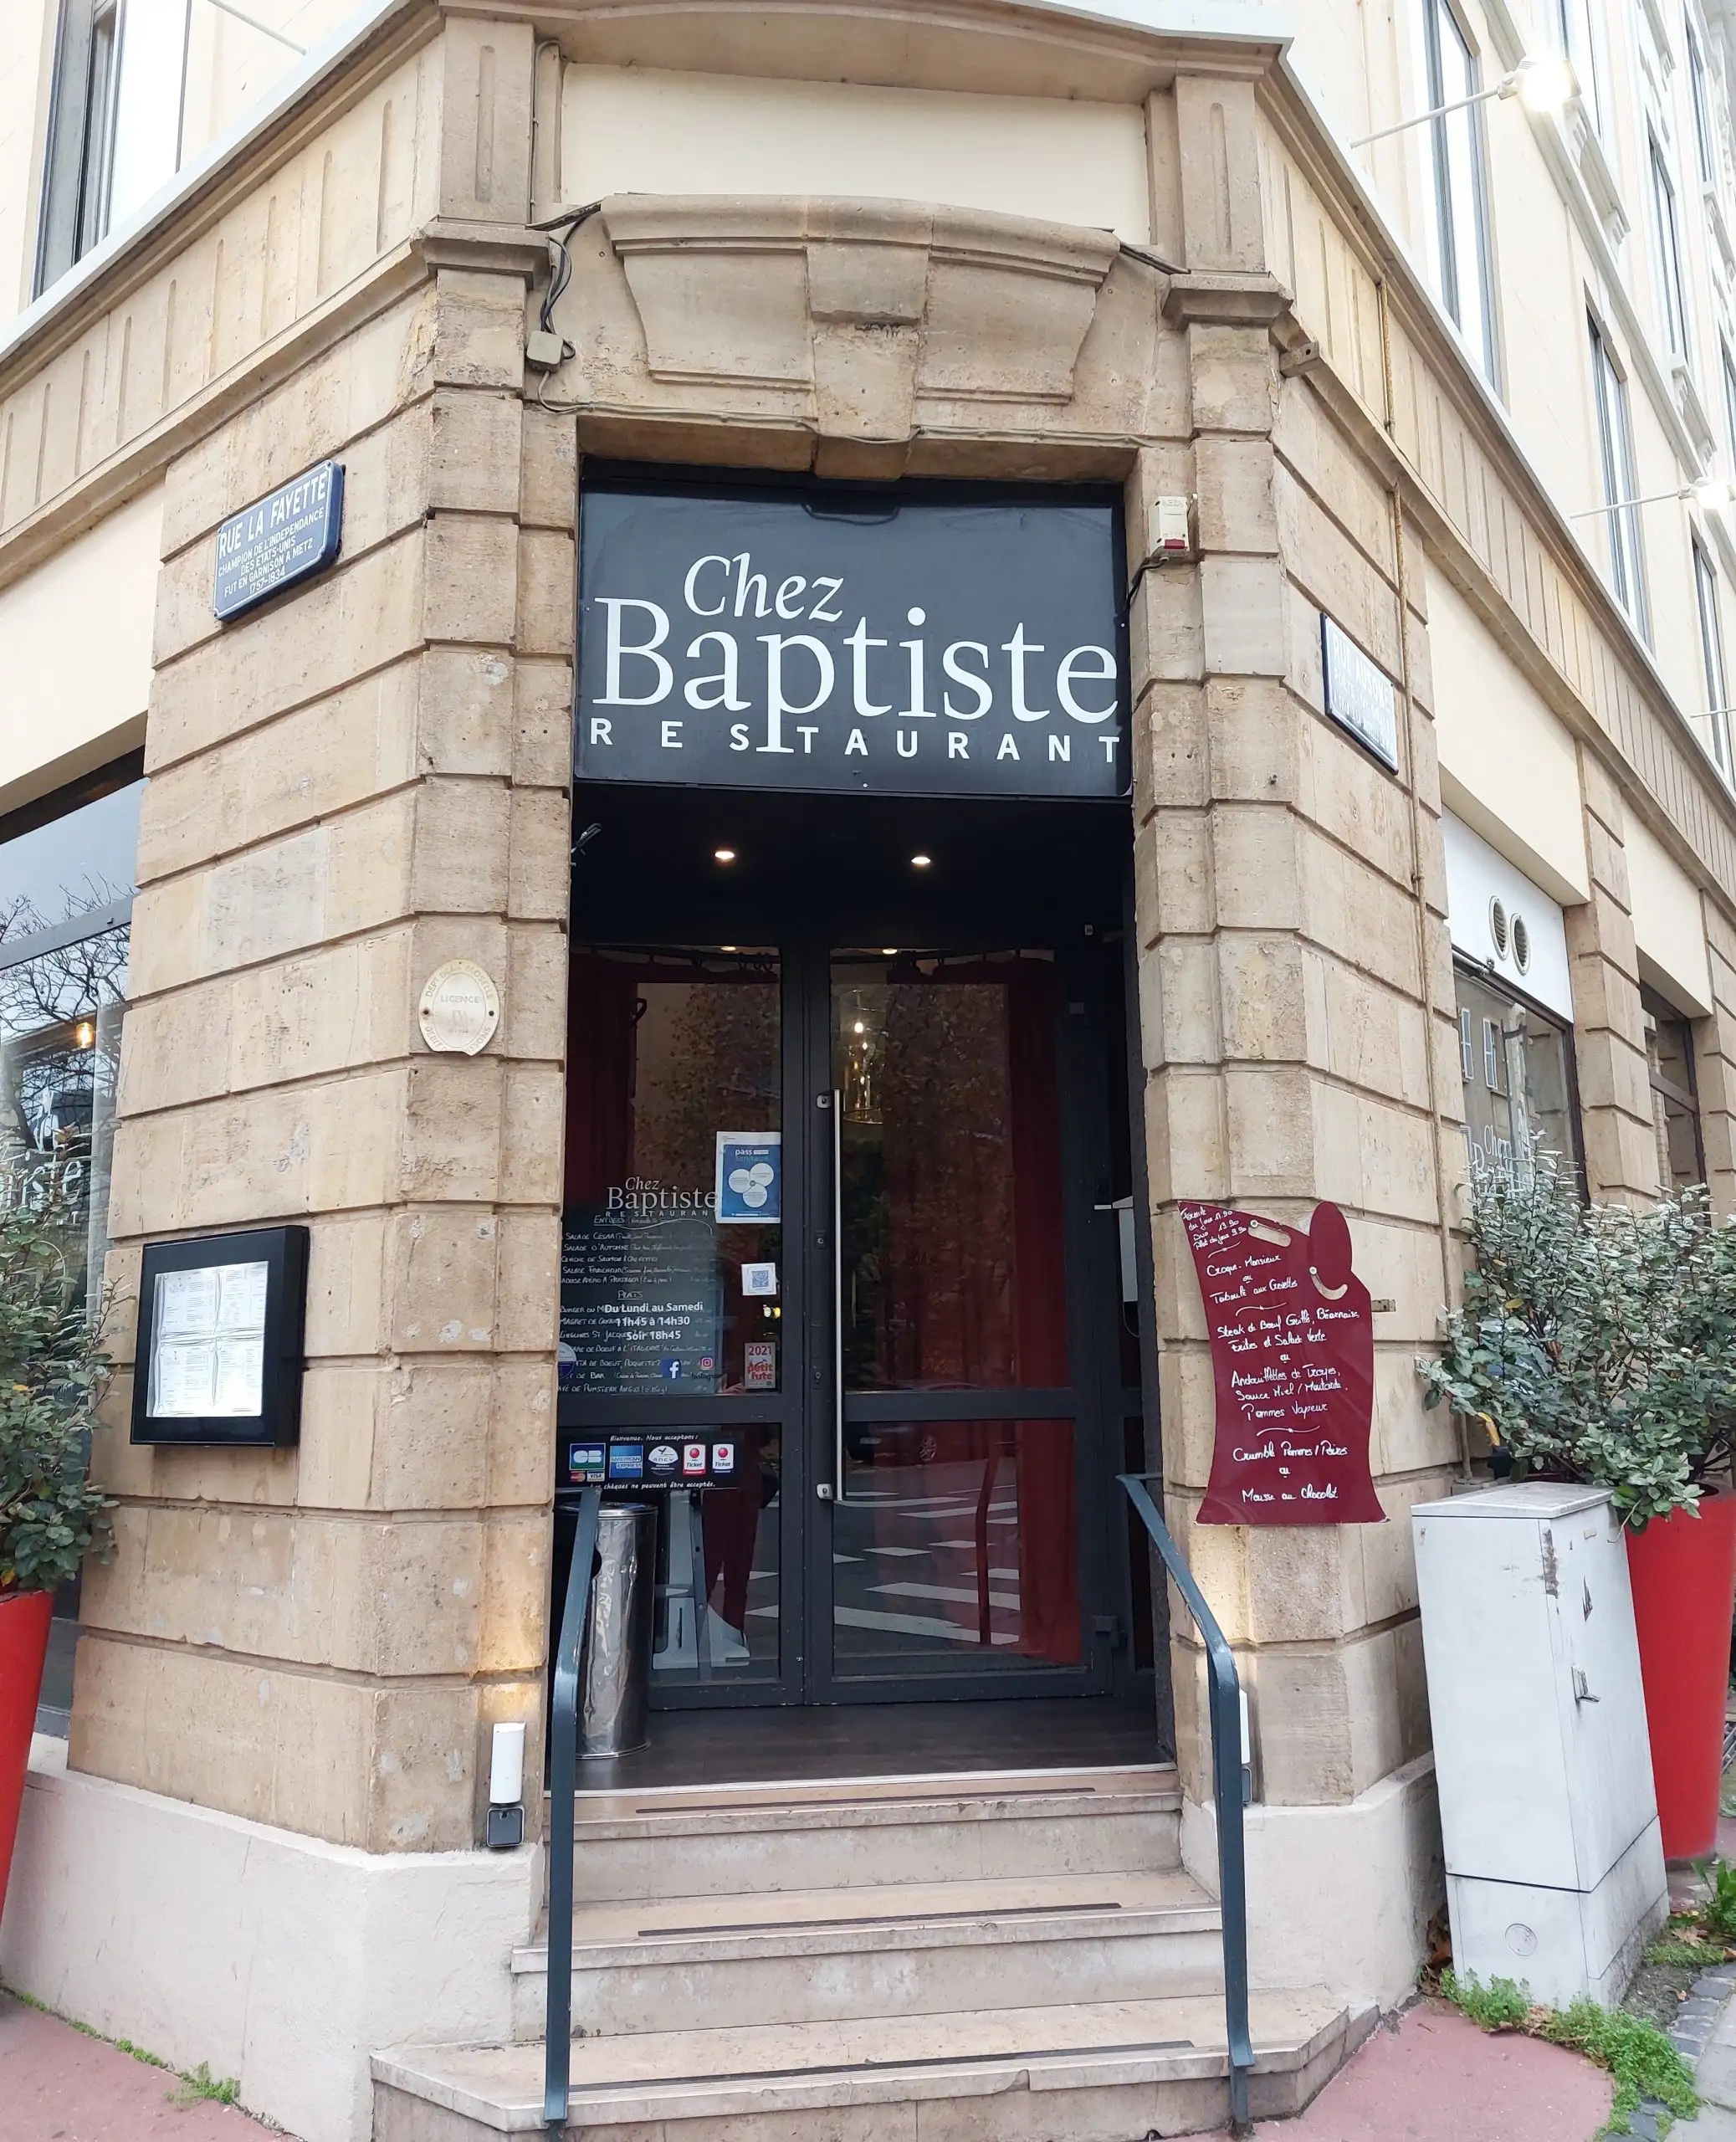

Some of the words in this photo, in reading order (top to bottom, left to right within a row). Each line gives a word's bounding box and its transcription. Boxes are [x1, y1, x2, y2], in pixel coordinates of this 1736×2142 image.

[219, 521, 243, 560] RUE
[248, 509, 264, 542] LA
[269, 471, 328, 529] FAYETTE
[218, 548, 253, 577] CHAMPION
[253, 542, 264, 556] DE
[264, 506, 325, 551] L'INDEPENDANCE
[241, 560, 253, 577] DES
[256, 536, 296, 562] ETATS-UNIS
[224, 581, 237, 598] FUT
[238, 576, 248, 589] EN
[248, 556, 284, 582] GARNISON
[292, 537, 314, 558] METZ
[683, 552, 844, 623] Chez
[591, 597, 1119, 753] Baptiste
[591, 716, 1120, 763] RESTAURANT
[440, 995, 480, 1004] LICENCE
[735, 1149, 753, 1157] pass
[625, 1176, 660, 1191] Chez
[606, 1185, 716, 1217] Baptiste
[1193, 1232, 1208, 1241] Duo
[1253, 1286, 1267, 1295] aux
[604, 1304, 619, 1313] Du
[621, 1303, 649, 1313] Lundi
[666, 1301, 704, 1312] Samedi
[616, 1316, 647, 1326] 11h45
[649, 1317, 656, 1325] à
[659, 1316, 690, 1325] 14h30
[626, 1330, 647, 1340] Soir
[650, 1330, 682, 1340] 18h45
[1217, 1325, 1245, 1339] Steak
[1247, 1323, 1257, 1333] de
[1228, 1339, 1257, 1352] Frites
[1263, 1335, 1272, 1347] et
[1274, 1331, 1303, 1346] Salade
[1307, 1328, 1327, 1342] Verte
[749, 1345, 771, 1355] 2021
[1292, 1368, 1302, 1378] de
[1236, 1390, 1270, 1401] Sauce
[1242, 1403, 1285, 1421] Pommes
[1292, 1401, 1328, 1419] Vapeur
[573, 1450, 602, 1463] CB
[1233, 1441, 1275, 1462] Crumble
[1242, 1488, 1276, 1503] Mousse
[1301, 1483, 1339, 1499] Chocolat
